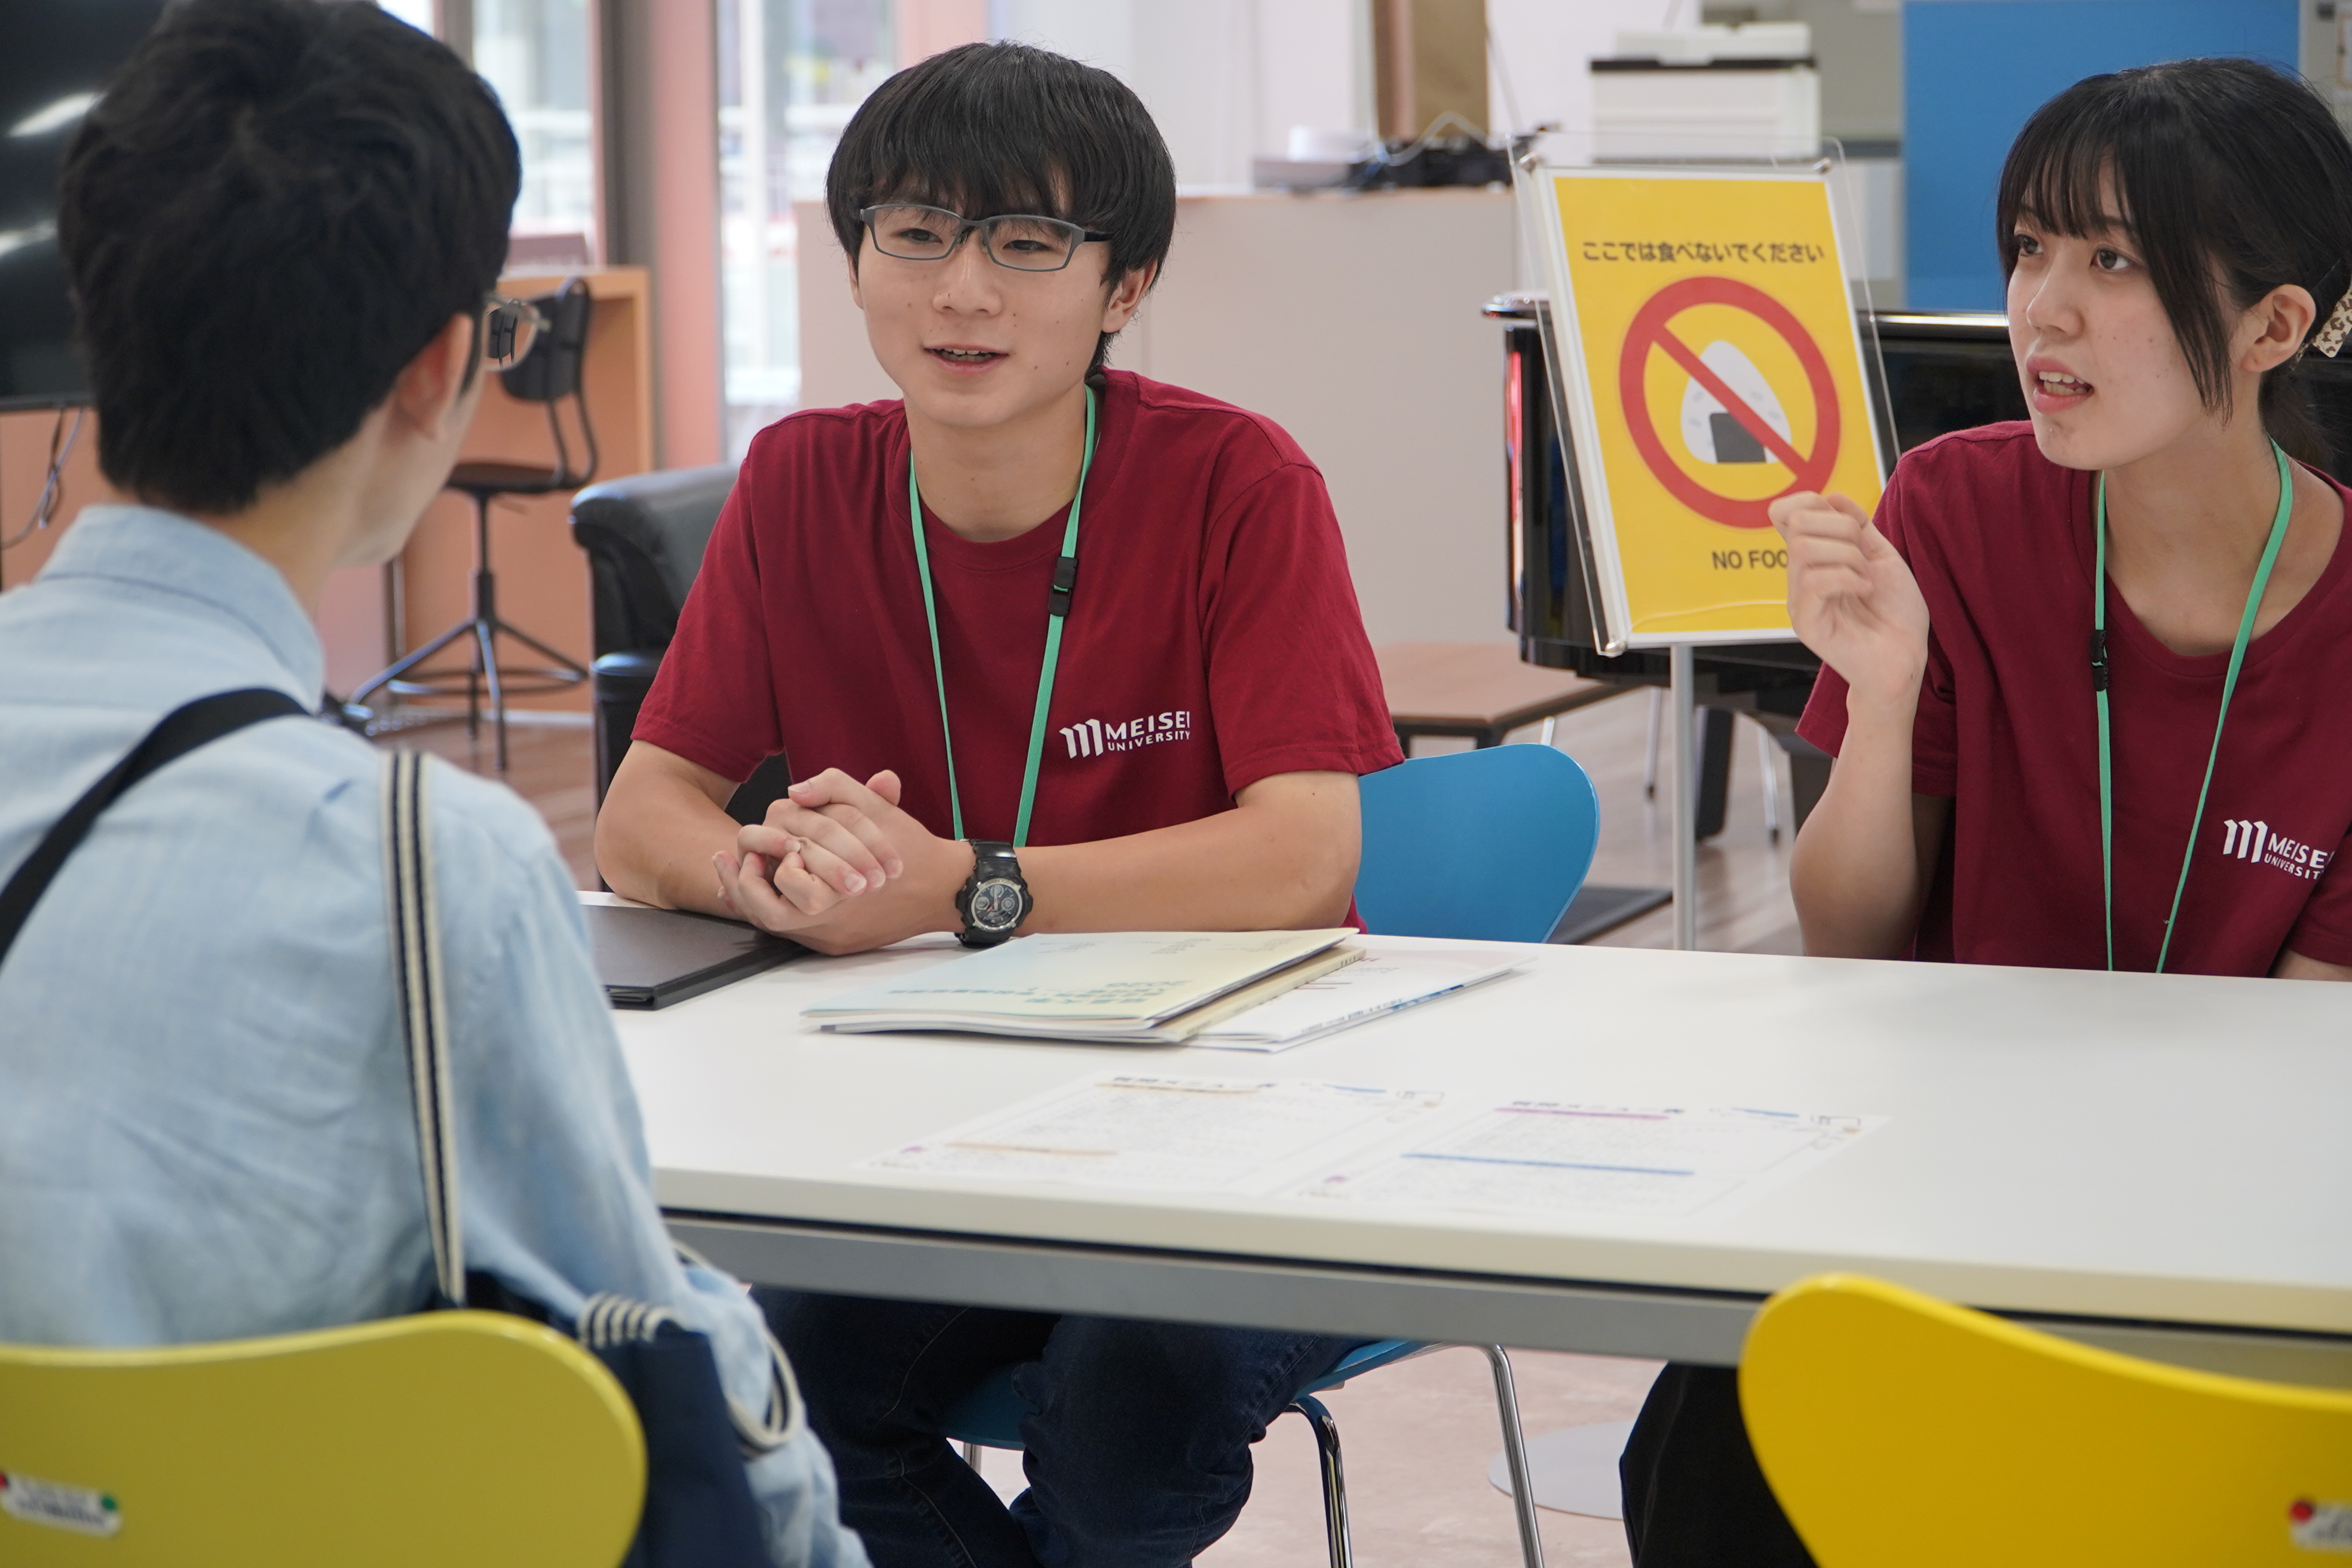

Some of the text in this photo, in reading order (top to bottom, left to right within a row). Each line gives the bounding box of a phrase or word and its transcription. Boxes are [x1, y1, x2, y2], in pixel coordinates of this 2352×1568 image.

[1583, 241, 1824, 263] ここでは食べないでください
[1712, 549, 1788, 570] NO FOO
[1105, 710, 1190, 740] MEISEI
[1107, 730, 1190, 752] UNIVERSITY
[2264, 853, 2325, 880] UNIVERSIT
